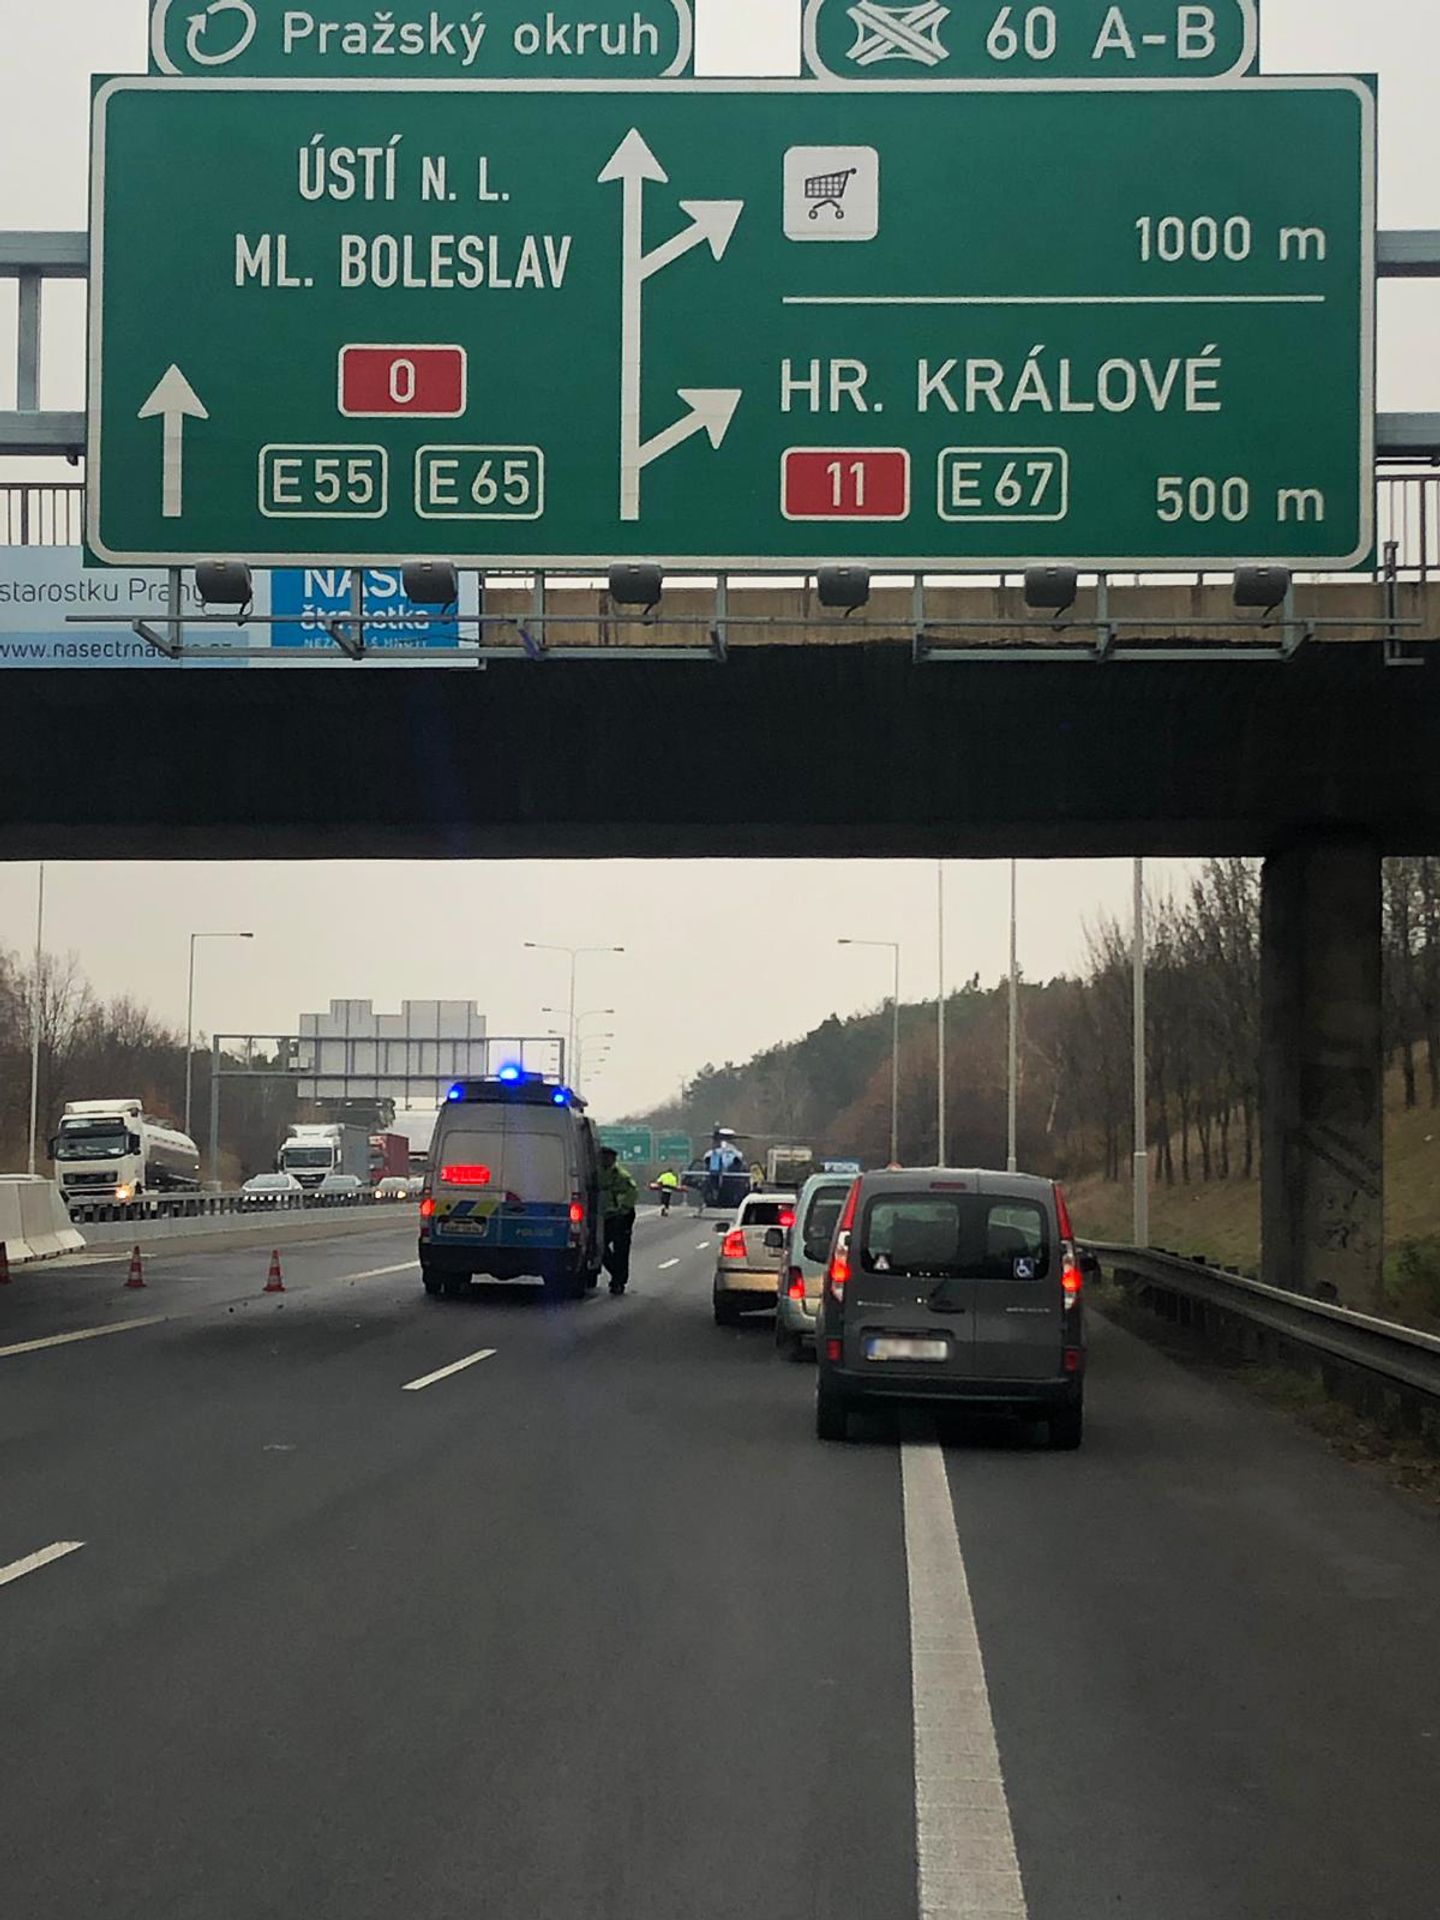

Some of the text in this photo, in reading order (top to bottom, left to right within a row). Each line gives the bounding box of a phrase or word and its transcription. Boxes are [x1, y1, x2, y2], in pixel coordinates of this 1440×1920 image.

[283, 11, 659, 66] Pražský okruh
[986, 5, 1217, 60] 60 A-B
[299, 133, 510, 201] ÚSTÍ N. L.
[235, 233, 573, 289] ML. BOLESLAV
[1135, 216, 1326, 262] 1000 m
[388, 358, 416, 405] 0
[780, 344, 1222, 412] HR. KRÁLOVÉ
[827, 461, 865, 507] 11
[1156, 477, 1325, 522] 500 m
[0, 578, 119, 602] starostku
